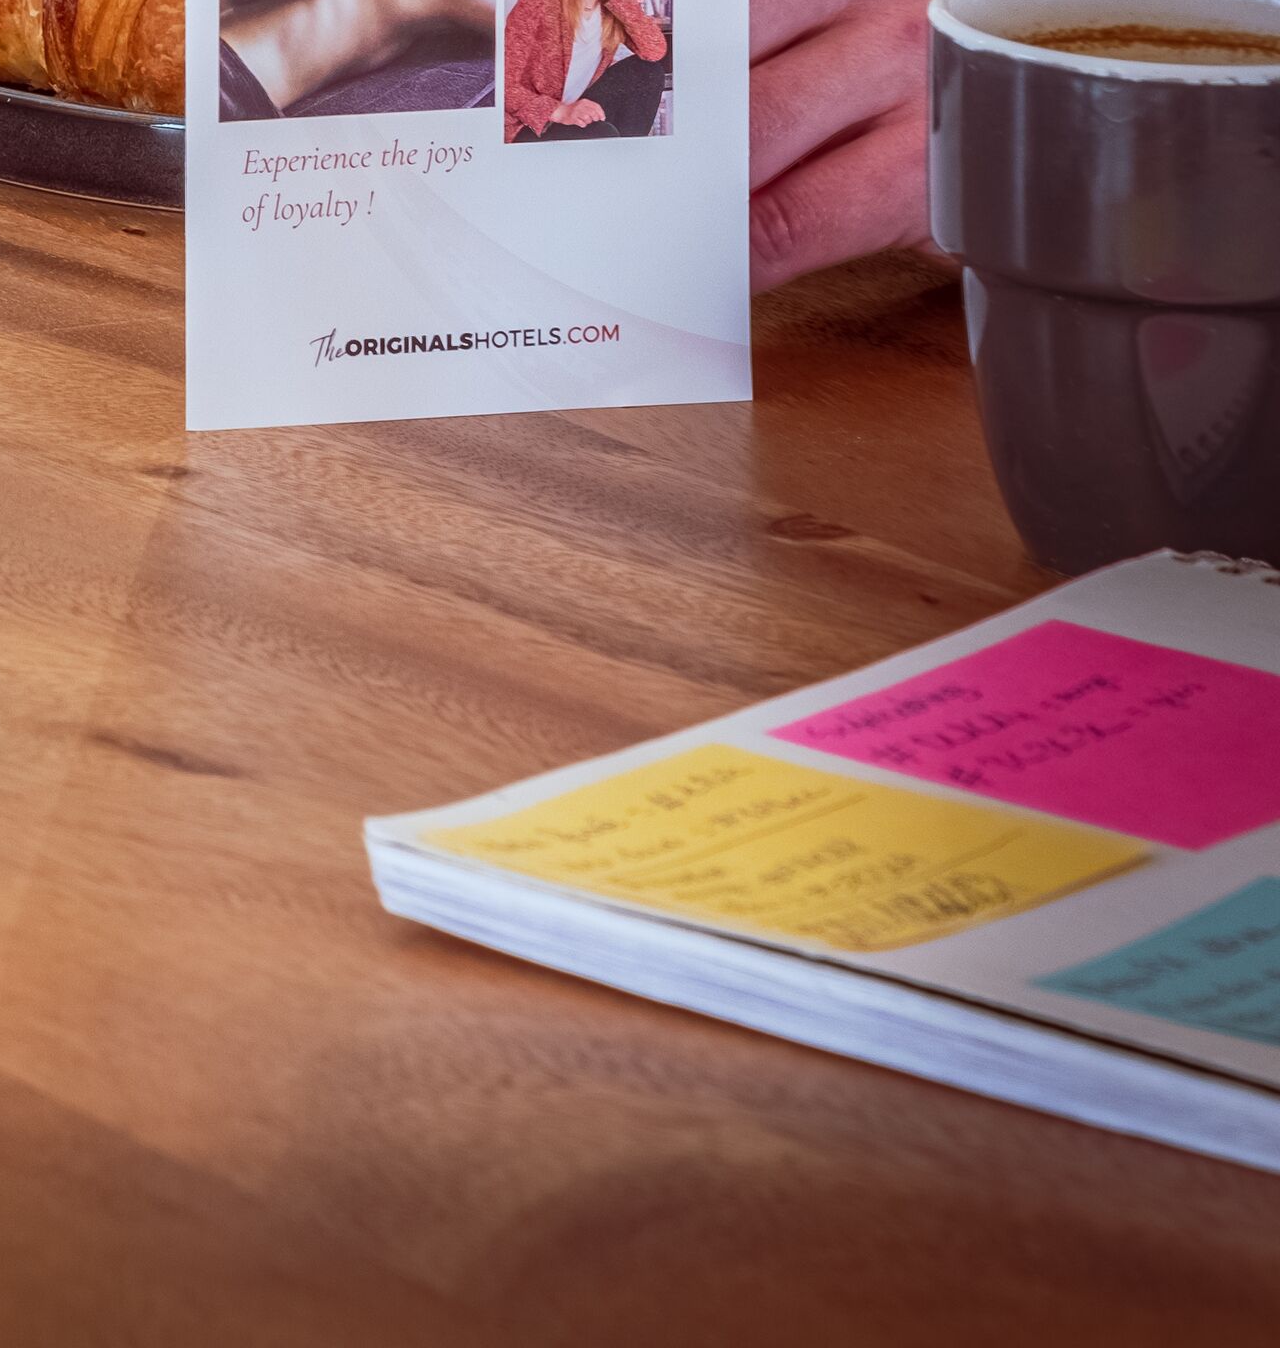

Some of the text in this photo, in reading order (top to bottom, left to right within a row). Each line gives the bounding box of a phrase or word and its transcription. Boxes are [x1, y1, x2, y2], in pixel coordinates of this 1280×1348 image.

[242, 139, 473, 182] Experience the joys
[242, 193, 269, 231] of
[274, 190, 358, 229] loyalty
